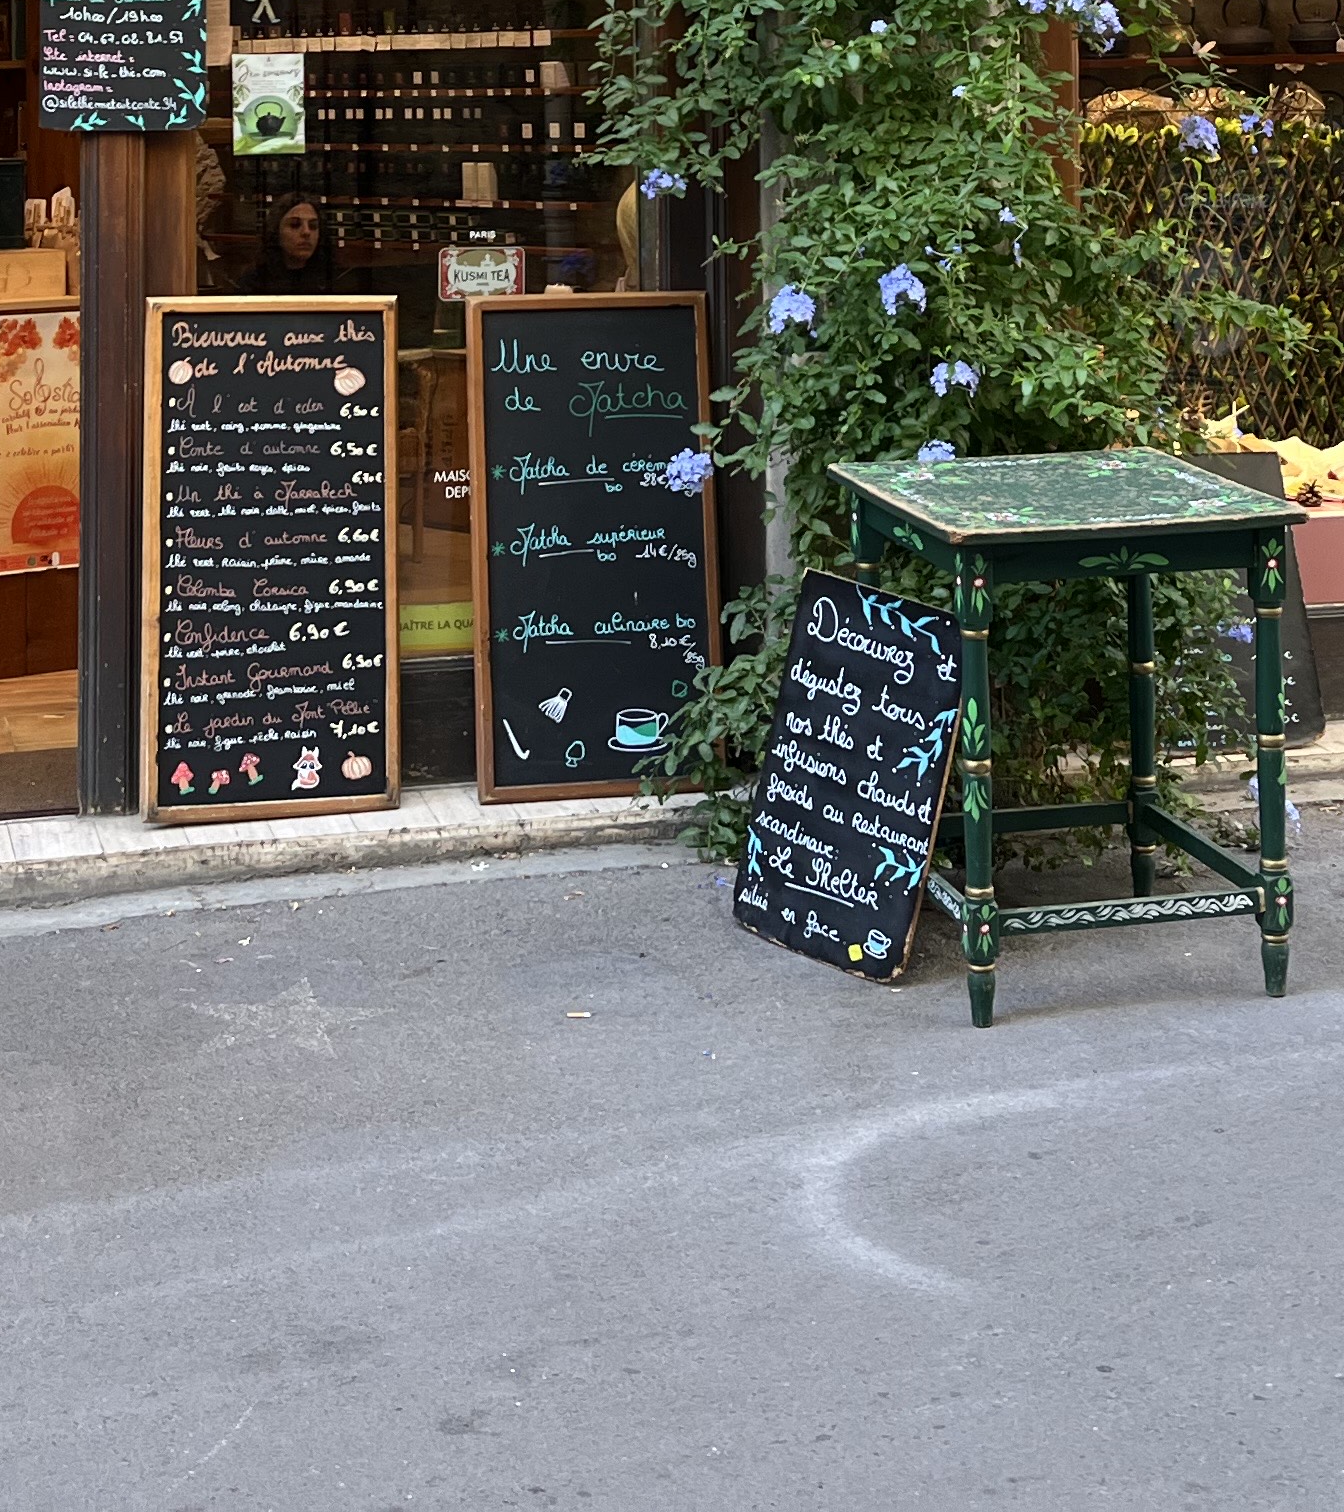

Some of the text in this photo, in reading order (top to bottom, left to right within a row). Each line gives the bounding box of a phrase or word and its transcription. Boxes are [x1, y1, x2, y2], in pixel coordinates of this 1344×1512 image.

[470, 231, 496, 239] PARIS
[454, 269, 510, 284] KUSMI TEA
[172, 320, 376, 348] Bienvenue aux thés
[195, 350, 347, 378] de l'Automne
[491, 339, 665, 374] Une envie
[506, 387, 541, 412] de
[180, 437, 224, 457] Conte
[586, 455, 608, 474] de
[176, 486, 201, 503] Un
[214, 481, 242, 502] thé
[254, 490, 264, 500] à
[176, 526, 224, 550] Fleurs
[587, 525, 665, 547] supérieur
[596, 550, 617, 561] bio
[253, 578, 309, 597] Corsica
[175, 619, 270, 651] Confidence
[438, 621, 451, 629] LA
[594, 612, 670, 634] culinaire
[676, 614, 696, 628] bio
[807, 597, 957, 684] Découvrez et
[175, 662, 333, 691] Instant Gourmand
[790, 658, 926, 730] dégustez tous
[203, 713, 254, 738] jardin
[263, 712, 282, 725] du
[787, 712, 883, 761] nos thés et
[772, 736, 931, 825] infusions chauds et
[767, 773, 928, 856] froids au restaurant
[769, 846, 879, 910] Le Shelter
[739, 884, 768, 911] situé
[781, 907, 796, 924] en
